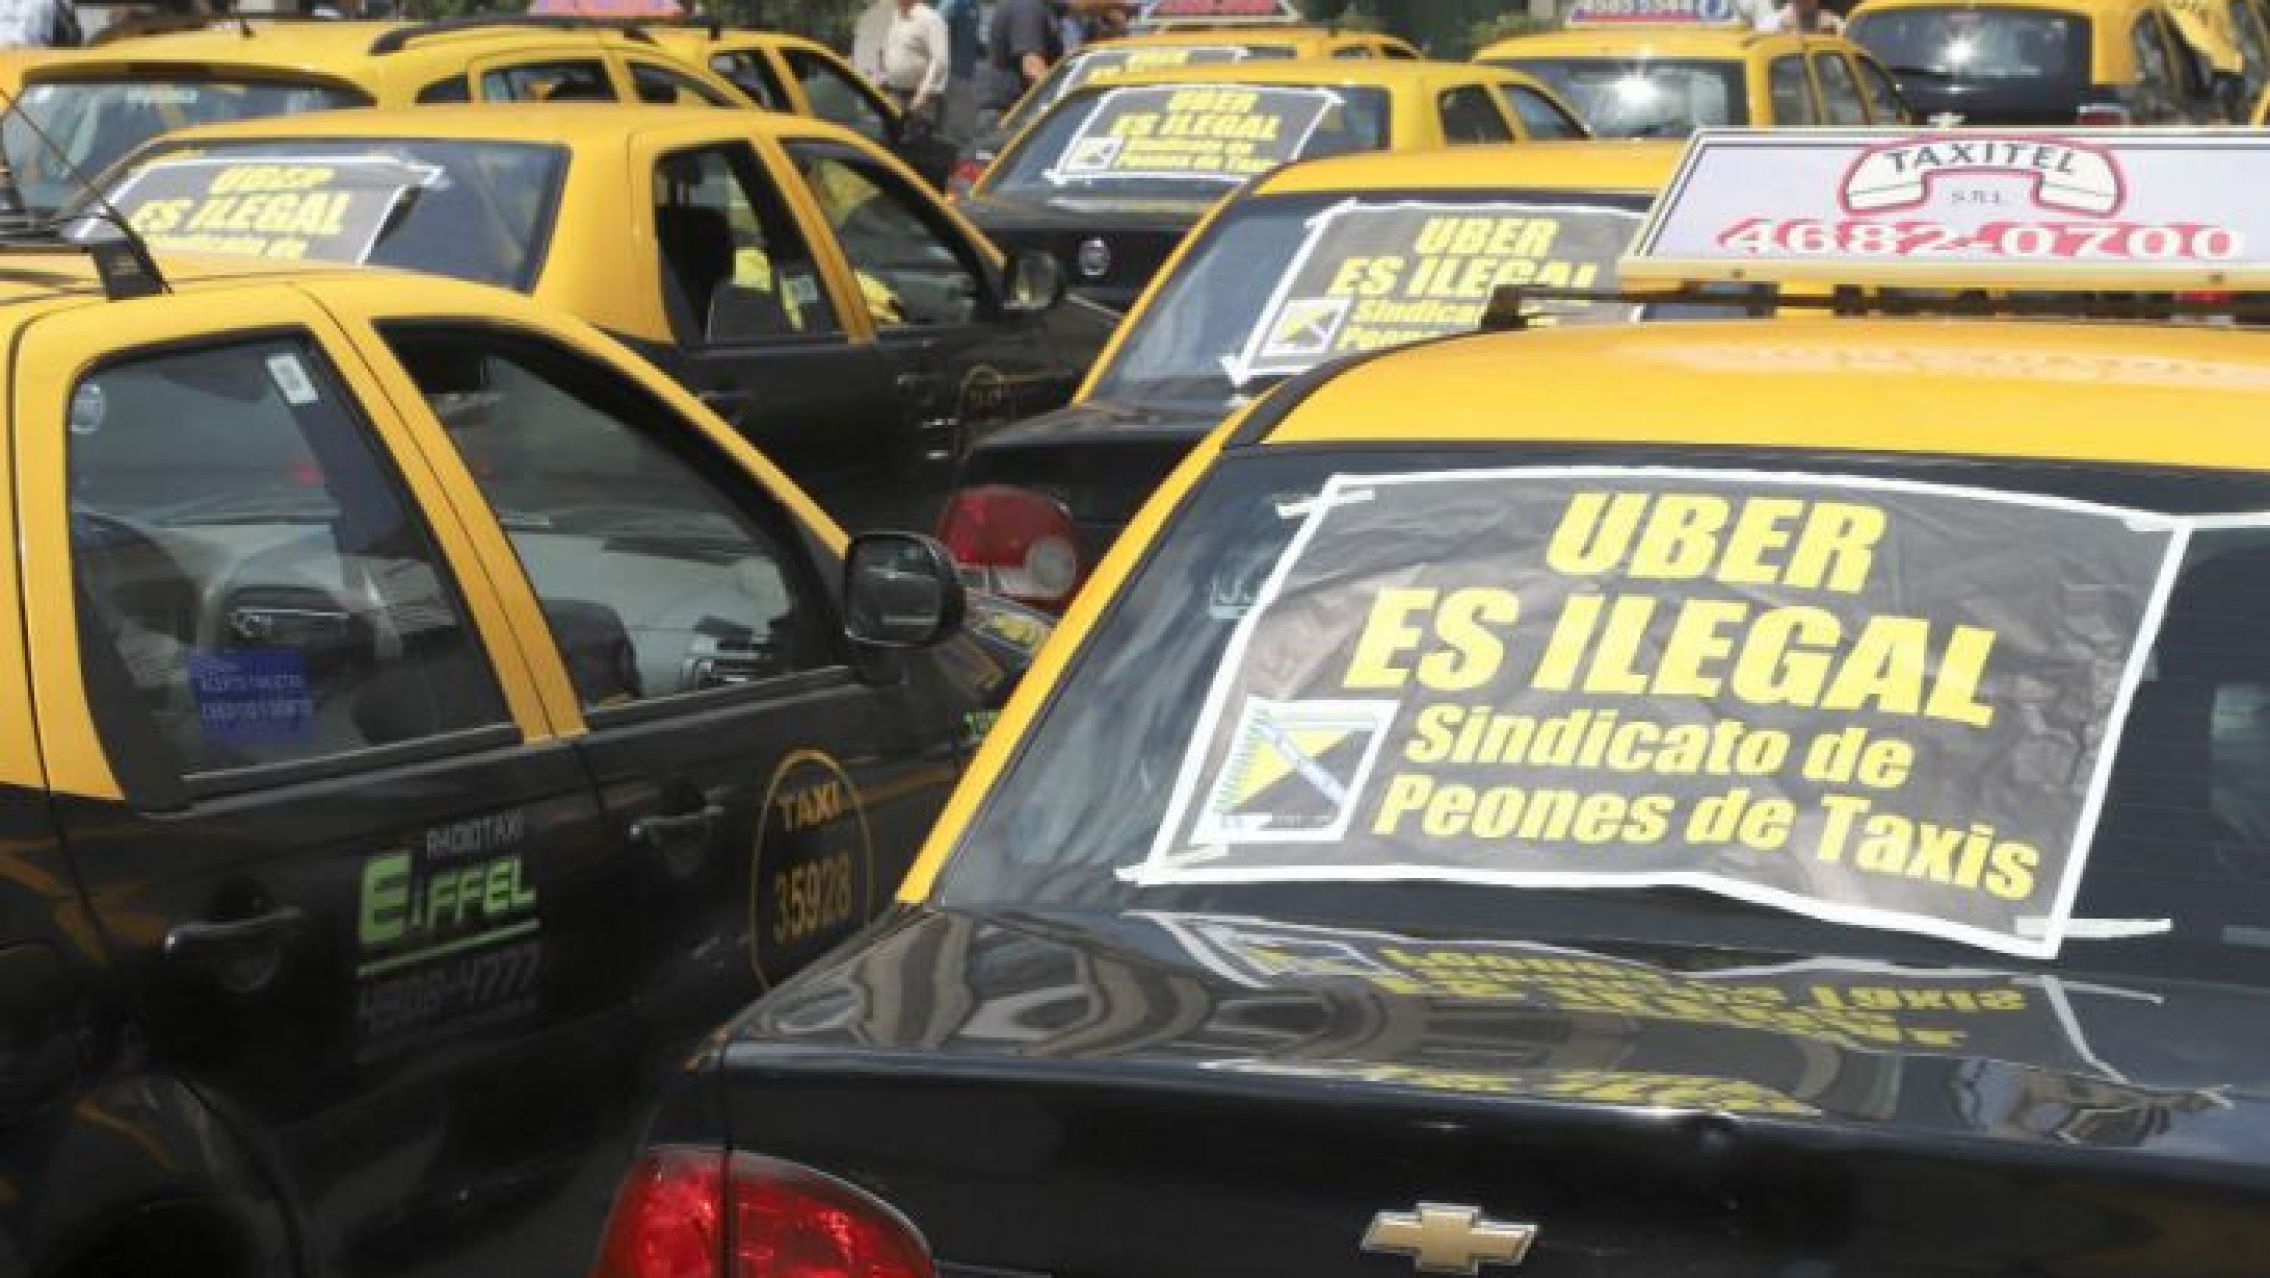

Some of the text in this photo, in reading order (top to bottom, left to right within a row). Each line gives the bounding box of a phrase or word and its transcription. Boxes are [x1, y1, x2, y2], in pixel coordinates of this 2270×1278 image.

[1166, 90, 1258, 112] UBER
[1110, 112, 1282, 140] ES ILEGAL
[208, 165, 335, 194] UBER
[1889, 143, 2079, 175] TAXITEL
[187, 191, 351, 235] ILEGAL
[1413, 217, 1559, 257] UBER
[1717, 217, 2247, 259] 4682-0700
[1326, 255, 1404, 296] ES
[1545, 491, 1888, 594] UBER
[1342, 586, 1998, 728] ES ILEGAL
[1405, 703, 1916, 788] Sindicato de
[777, 780, 840, 830] TAXI
[1372, 772, 2041, 899] Peones de Taxis
[773, 851, 850, 944] 35928
